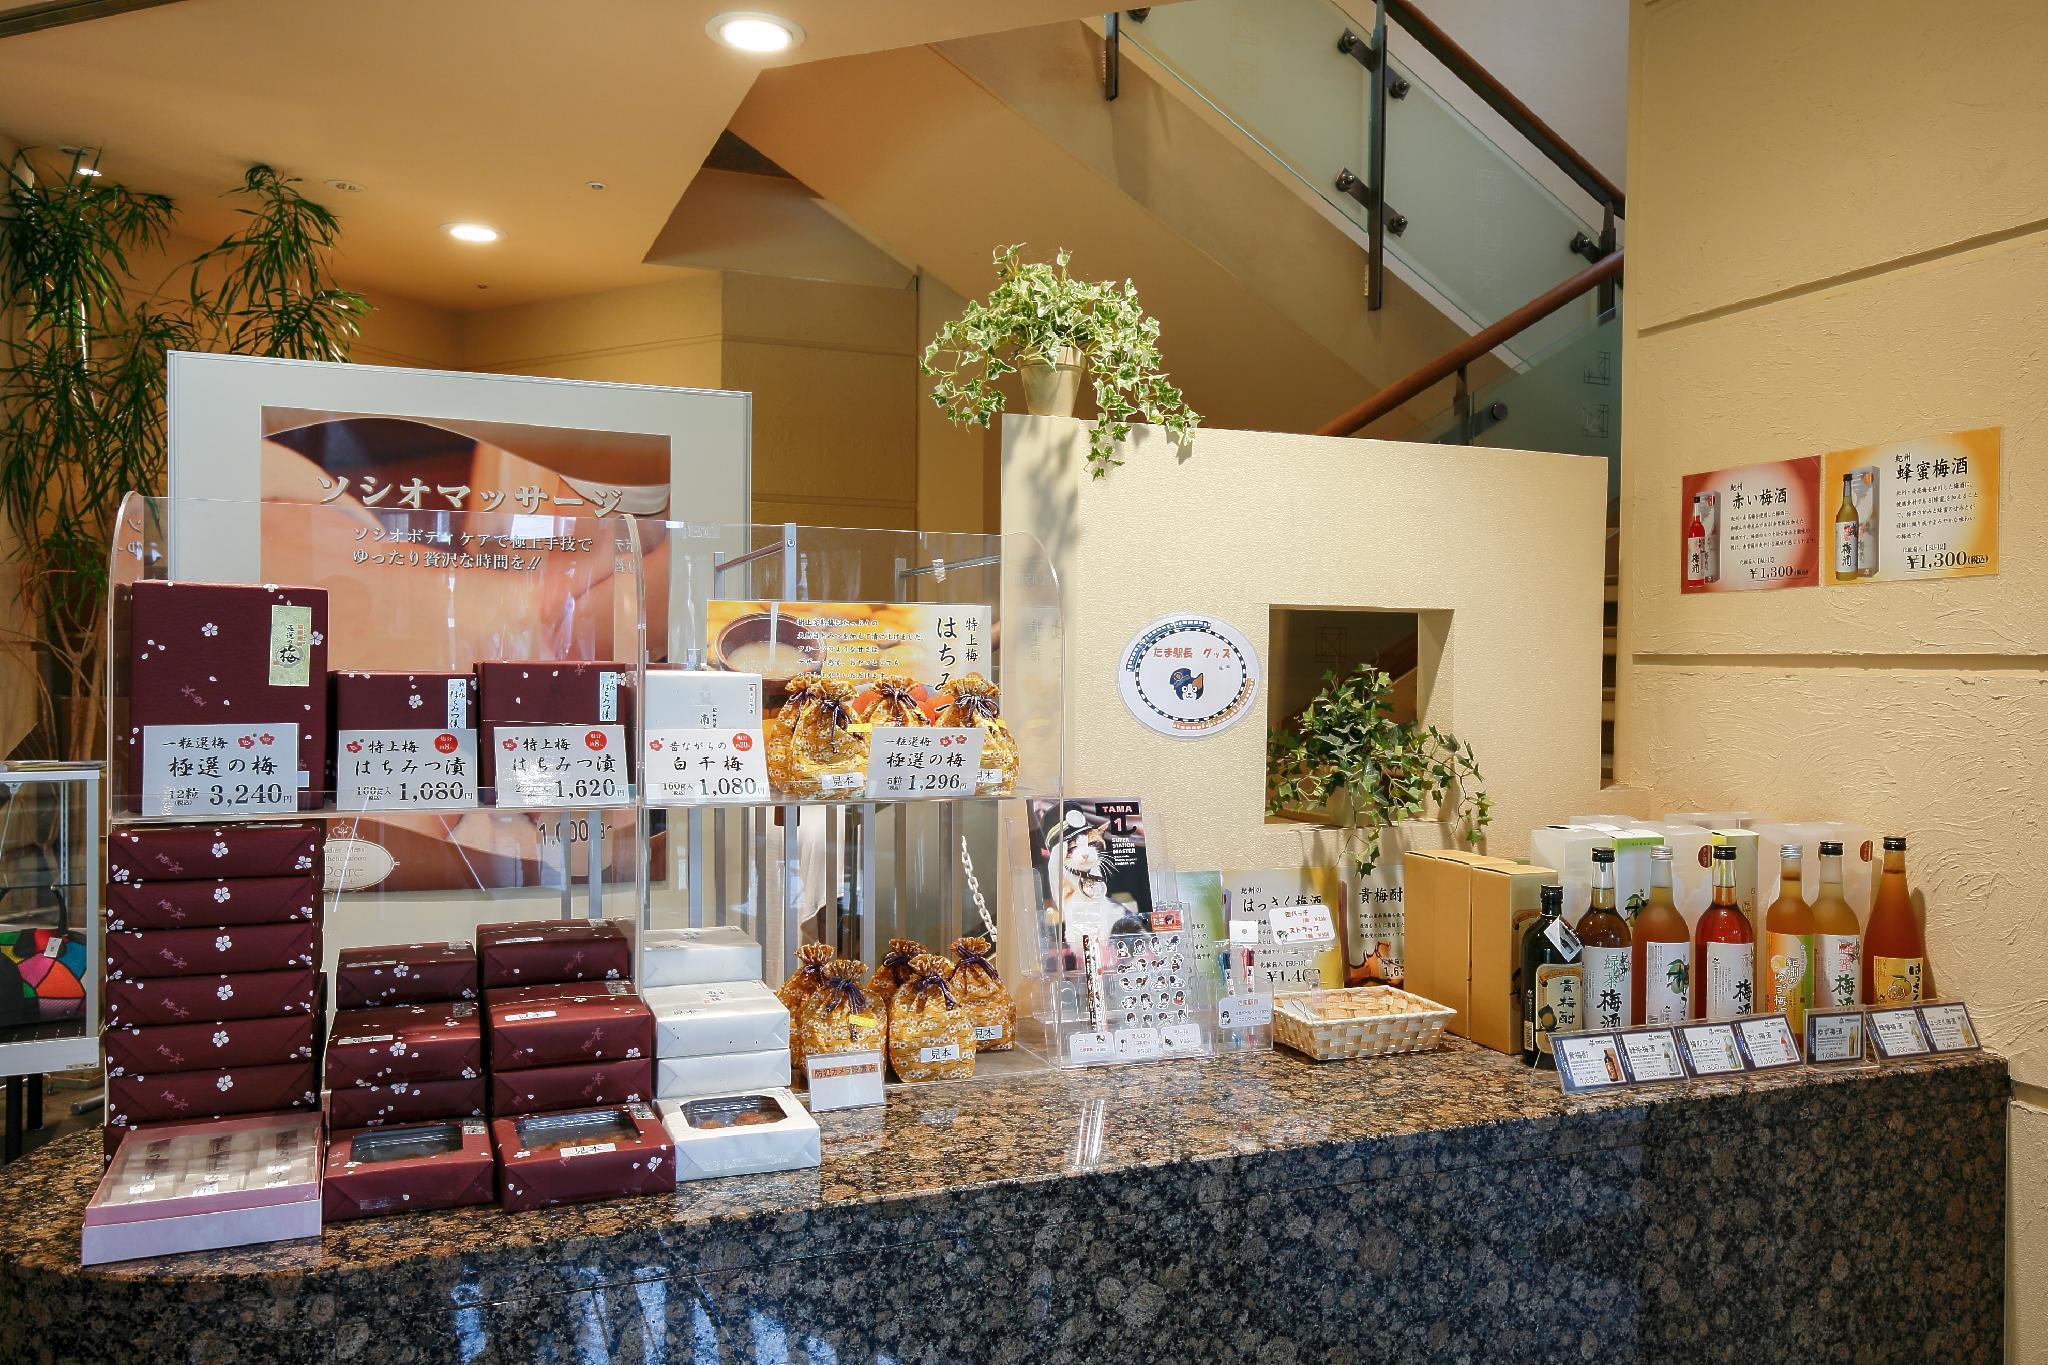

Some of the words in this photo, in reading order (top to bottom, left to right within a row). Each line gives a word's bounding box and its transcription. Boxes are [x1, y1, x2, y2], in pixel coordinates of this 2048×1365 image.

[1896, 456, 1968, 483] 蜂蜜梅酒
[318, 475, 623, 517] ソシオマッサージ
[1733, 488, 1787, 509] 赤い梅酒
[353, 527, 593, 552] ソシオボディケアで極上手技で
[966, 617, 978, 661] 特上梅
[1153, 647, 1192, 658] たま駅長
[163, 737, 228, 750] 一粒選梅
[368, 740, 419, 753] 特上梅
[523, 738, 571, 751] 特上梅
[670, 741, 727, 752] 昔ながらの
[884, 736, 932, 747] 一粒選梅
[168, 755, 278, 778] 極選の梅
[355, 757, 466, 776] はちみつ漬
[513, 754, 616, 772] はちみつ漬
[674, 755, 744, 771] 白干梅
[886, 752, 966, 769] 極選の梅
[555, 778, 625, 799] 1,620円
[699, 778, 765, 797] 1,080円
[832, 776, 854, 787] 見本
[908, 774, 967, 791] 1,296円
[210, 784, 292, 807] 3,240円
[400, 782, 473, 802] 1,080円
[1102, 805, 1132, 813] TAMA
[1114, 817, 1122, 832] 1
[1786, 957, 1800, 985] 紀州の
[1557, 979, 1576, 1025] 貴梅酎
[975, 1028, 995, 1039] 見本
[931, 1048, 952, 1060] 見本
